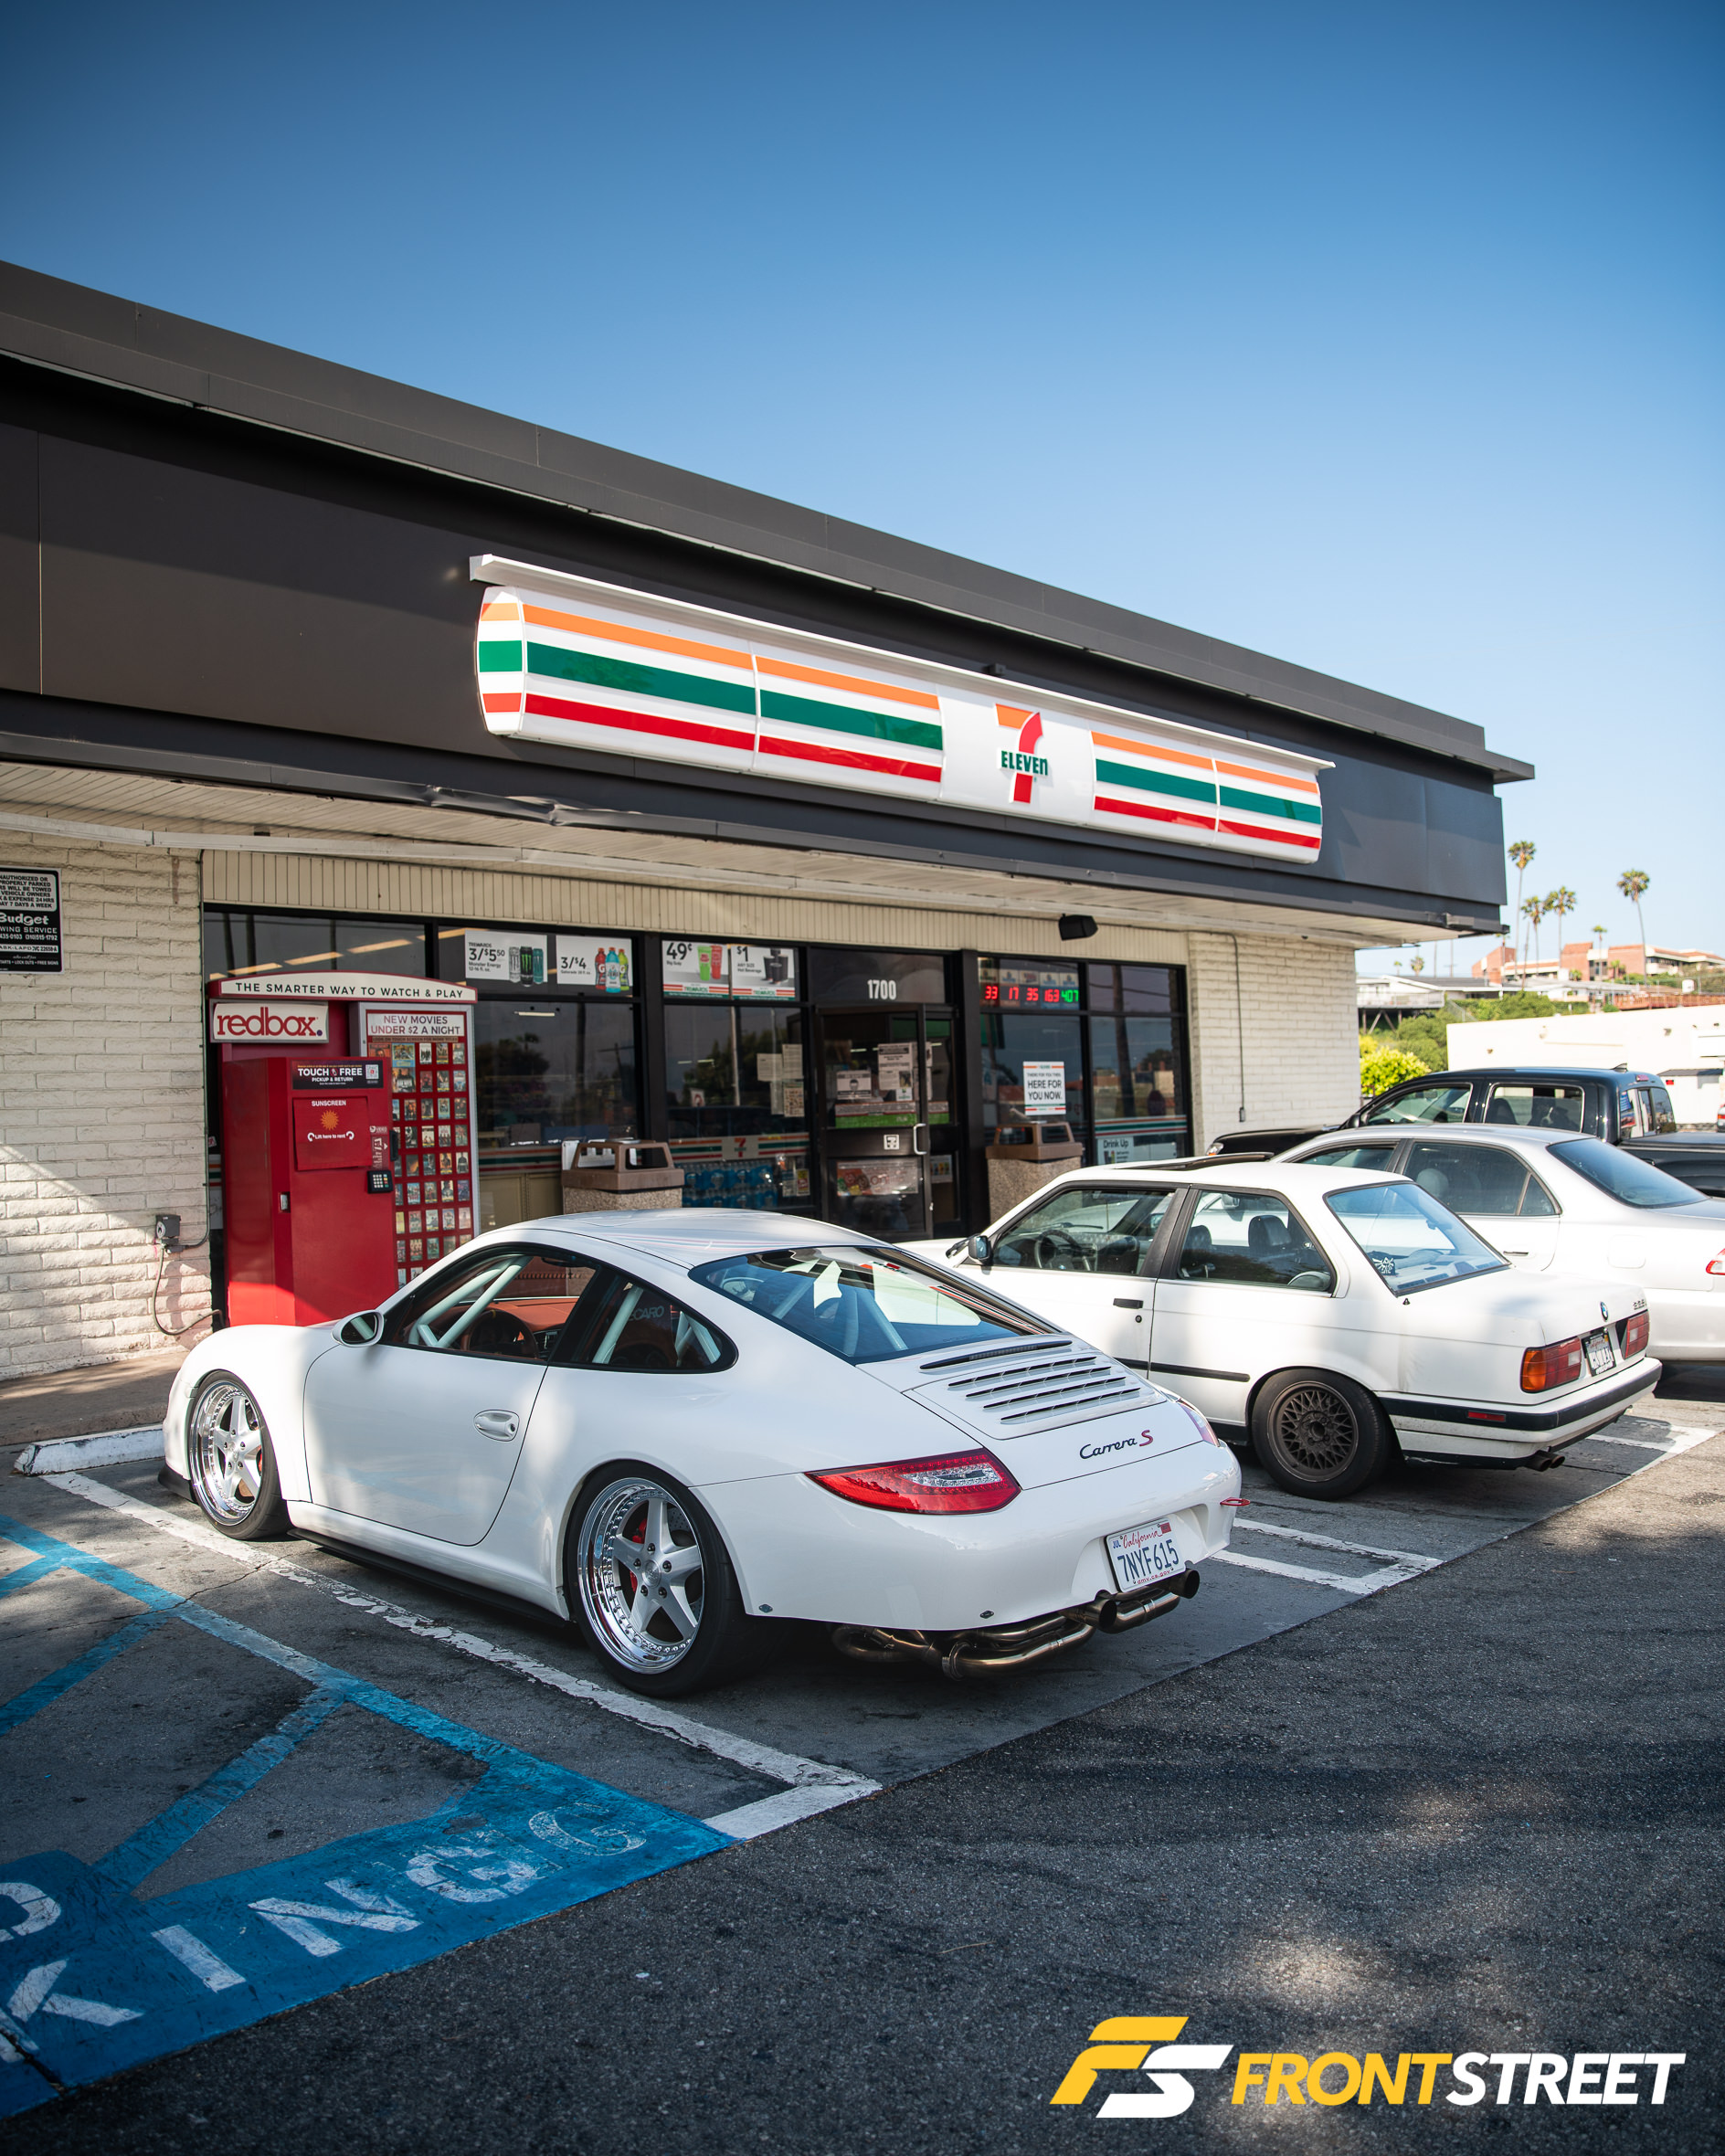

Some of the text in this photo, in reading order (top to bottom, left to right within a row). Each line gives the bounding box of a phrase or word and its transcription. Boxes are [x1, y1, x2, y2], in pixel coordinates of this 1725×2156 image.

[995, 703, 1043, 804] 7
[236, 983, 260, 992] THE
[266, 983, 324, 994] SMARTER
[330, 986, 356, 995] WAY
[361, 987, 376, 995] TO
[381, 988, 420, 997] WATCH
[436, 989, 463, 998] PLAY
[867, 979, 897, 1000] 1700
[985, 985, 999, 1000] 33
[1009, 987, 1019, 1000] 17
[1026, 988, 1039, 1001] 35
[1044, 988, 1060, 1002] 163
[384, 1015, 448, 1024] NEW MOVIES
[371, 1025, 460, 1035] UNDER $2 A NIGHT
[297, 1067, 363, 1077] TOUCH FREE
[1027, 1080, 1062, 1089] HERE FOR
[1028, 1091, 1043, 1100] YOU
[1103, 1139, 1129, 1149] Drink Up
[1079, 1430, 1154, 1459] Carrera S
[1123, 1528, 1163, 1549] California
[1117, 1539, 1179, 1582] 7NYF615
[1137, 1570, 1170, 1585] dmv.ca.gov
